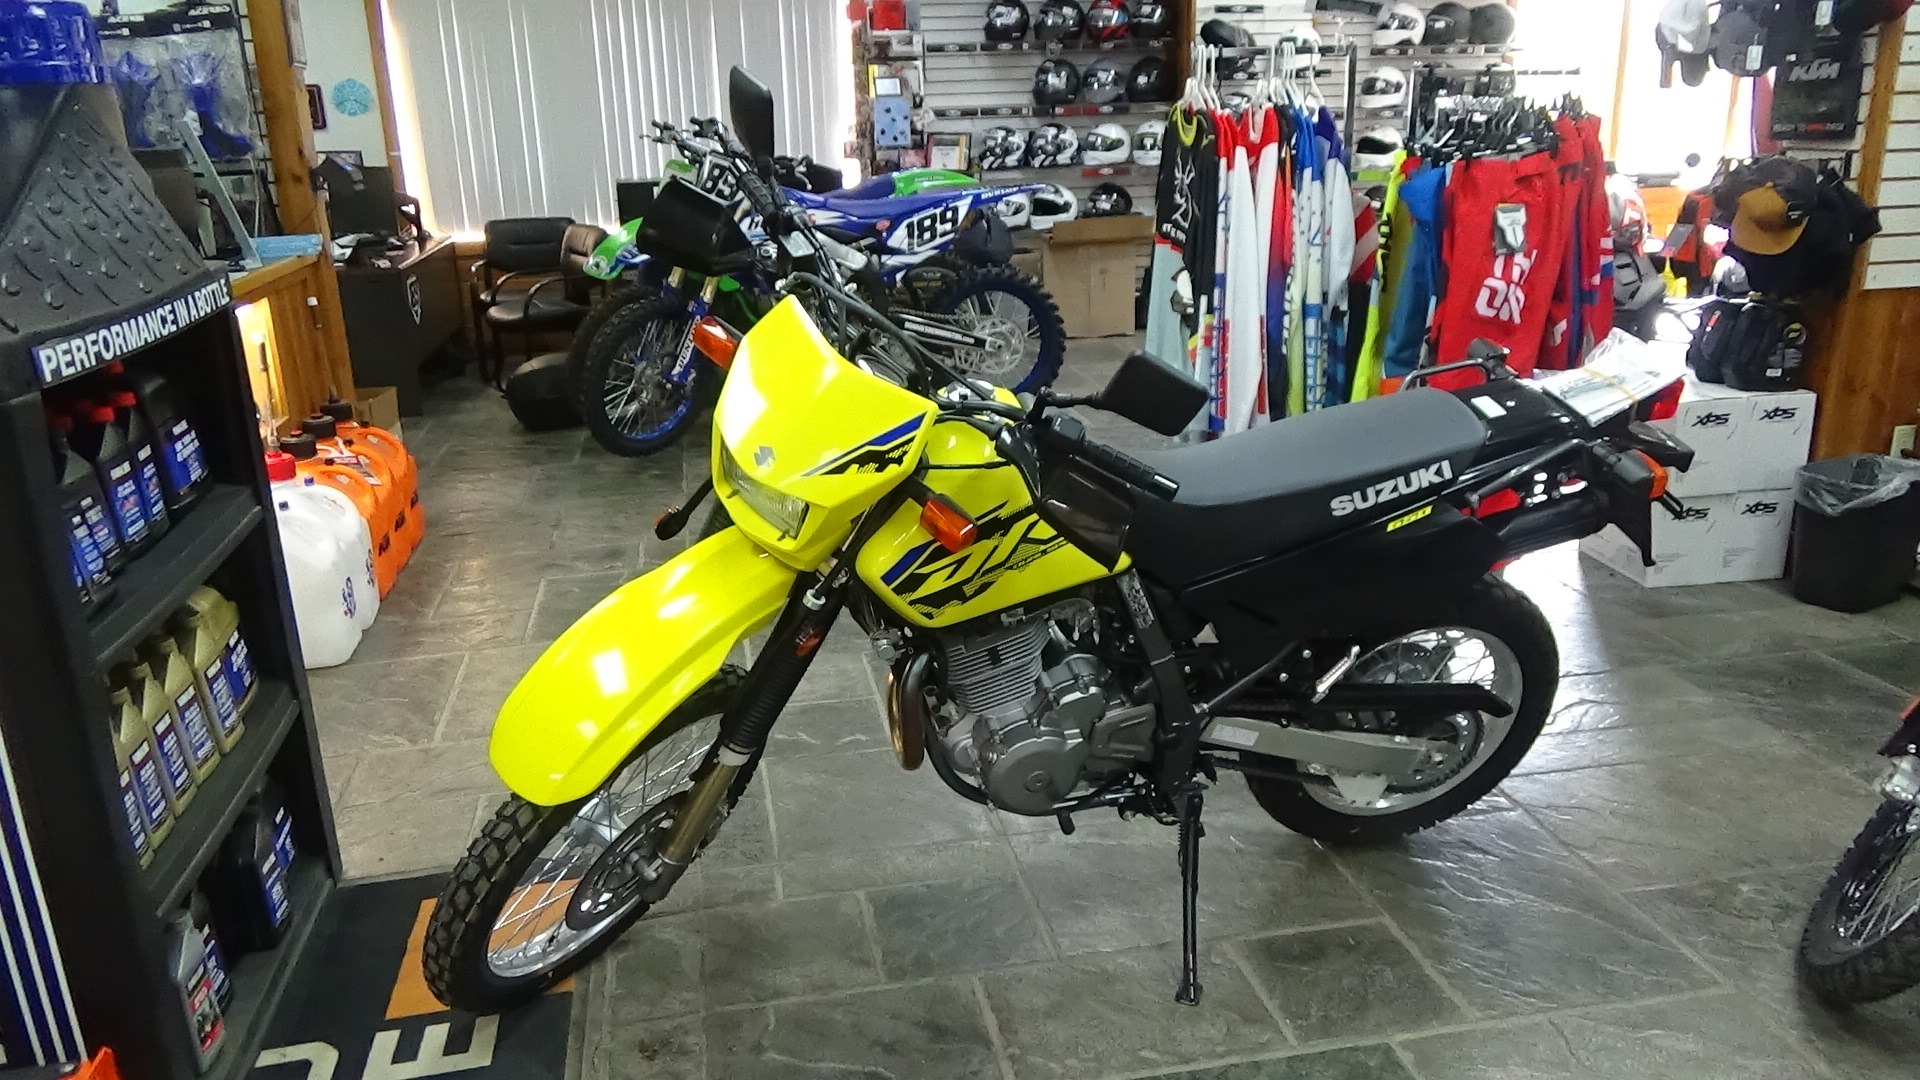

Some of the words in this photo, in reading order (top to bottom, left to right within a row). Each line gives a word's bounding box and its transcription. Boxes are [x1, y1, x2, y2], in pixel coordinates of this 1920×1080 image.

[1788, 58, 1841, 82] KTM
[906, 206, 959, 254] 189
[38, 304, 177, 383] PERFORMANCE
[173, 298, 190, 328] IN
[187, 294, 198, 323] A
[195, 278, 231, 317] BOTTLE
[1691, 412, 1732, 427] XPS
[1760, 406, 1800, 421] XPS
[1329, 459, 1453, 517] SUZUKI
[1741, 501, 1779, 515] XPS
